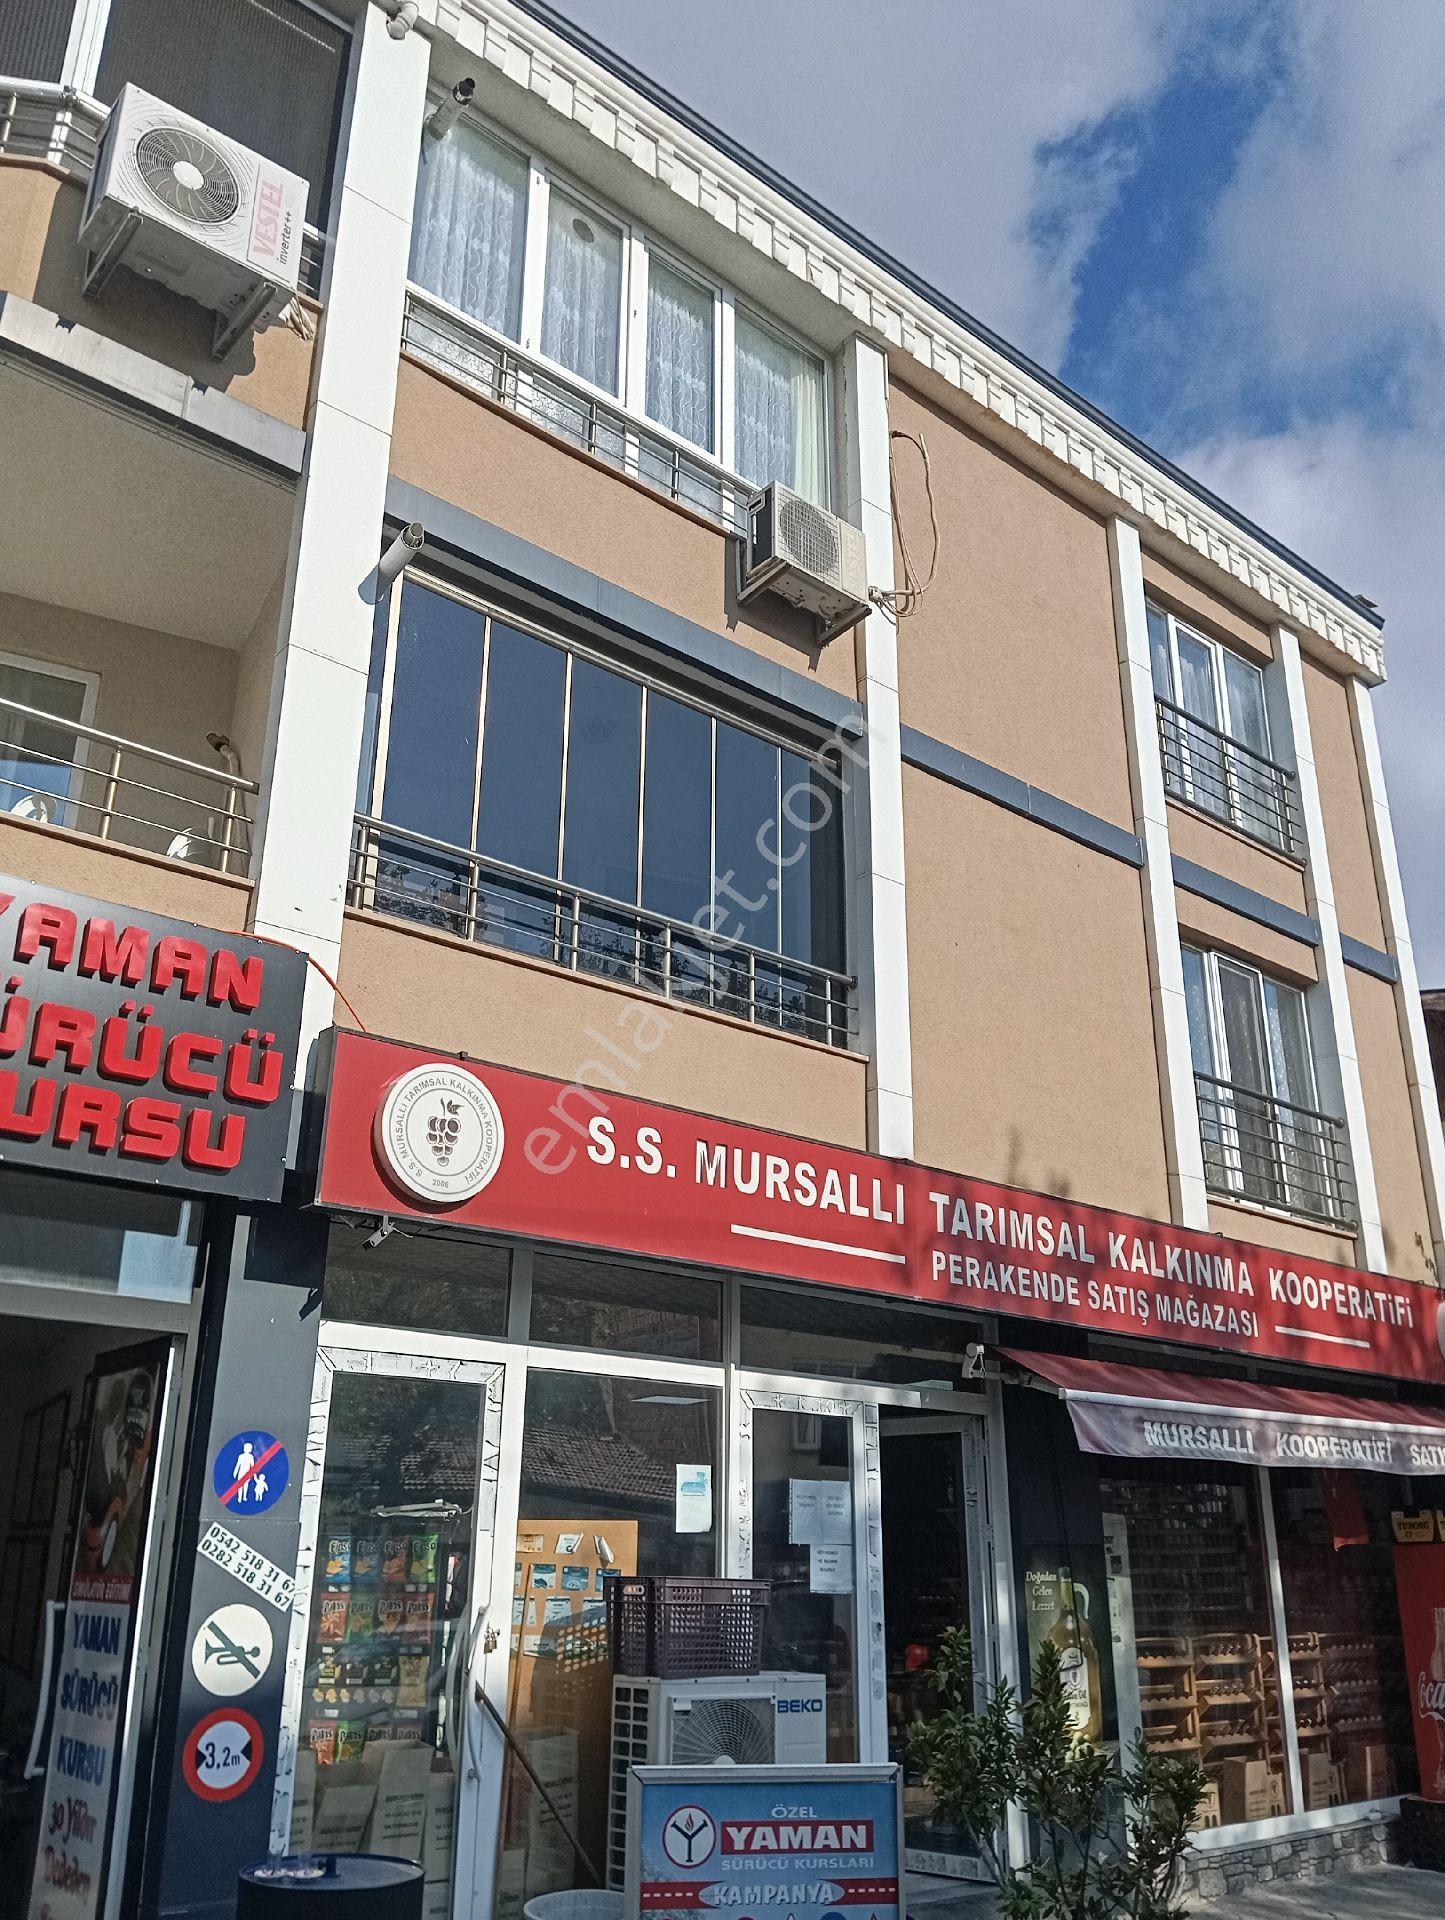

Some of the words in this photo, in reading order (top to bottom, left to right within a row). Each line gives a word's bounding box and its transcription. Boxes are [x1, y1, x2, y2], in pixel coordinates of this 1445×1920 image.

[253, 180, 283, 257] VESTEL
[0, 894, 264, 1009] AMAN
[403, 1077, 448, 1102] TARIMSAL
[449, 1079, 489, 1120] KALKINMA
[396, 1103, 411, 1159] MURSALLI
[432, 1178, 449, 1189] 2006
[587, 1115, 677, 1179] S.S.
[695, 1139, 905, 1225] MURSALLI
[929, 1191, 1095, 1265] TARIMSAL
[1108, 1231, 1255, 1297] KALKINMA
[931, 1249, 1081, 1306] PERAKENDE
[1088, 1279, 1150, 1326] SATIŞ
[1156, 1294, 1259, 1338] MAĞAZASI
[1143, 1421, 1255, 1455] MURSALLI
[210, 1526, 241, 1554] 0542
[241, 1550, 264, 1571] 518
[264, 1566, 280, 1582] 31
[201, 1539, 233, 1567] 0282
[233, 1562, 256, 1584] 518
[257, 1579, 272, 1596] 31
[274, 1592, 290, 1607] 67
[1025, 1571, 1057, 1585] Doğadan
[1032, 1586, 1053, 1597] Gelen
[1032, 1601, 1055, 1611] Lezzet
[73, 1613, 121, 1656] YAMAN
[60, 1667, 119, 1722] SÜRÜCÜ
[777, 1699, 823, 1714] BEKO
[56, 1735, 107, 1787] KURSU
[771, 1803, 819, 1819] ÖZEL
[726, 1825, 867, 1850] YAMAN
[721, 1856, 789, 1871] SÜRÜCÜ
[795, 1858, 874, 1870] KURSLARI
[714, 1882, 835, 1907] KAMPANYA
